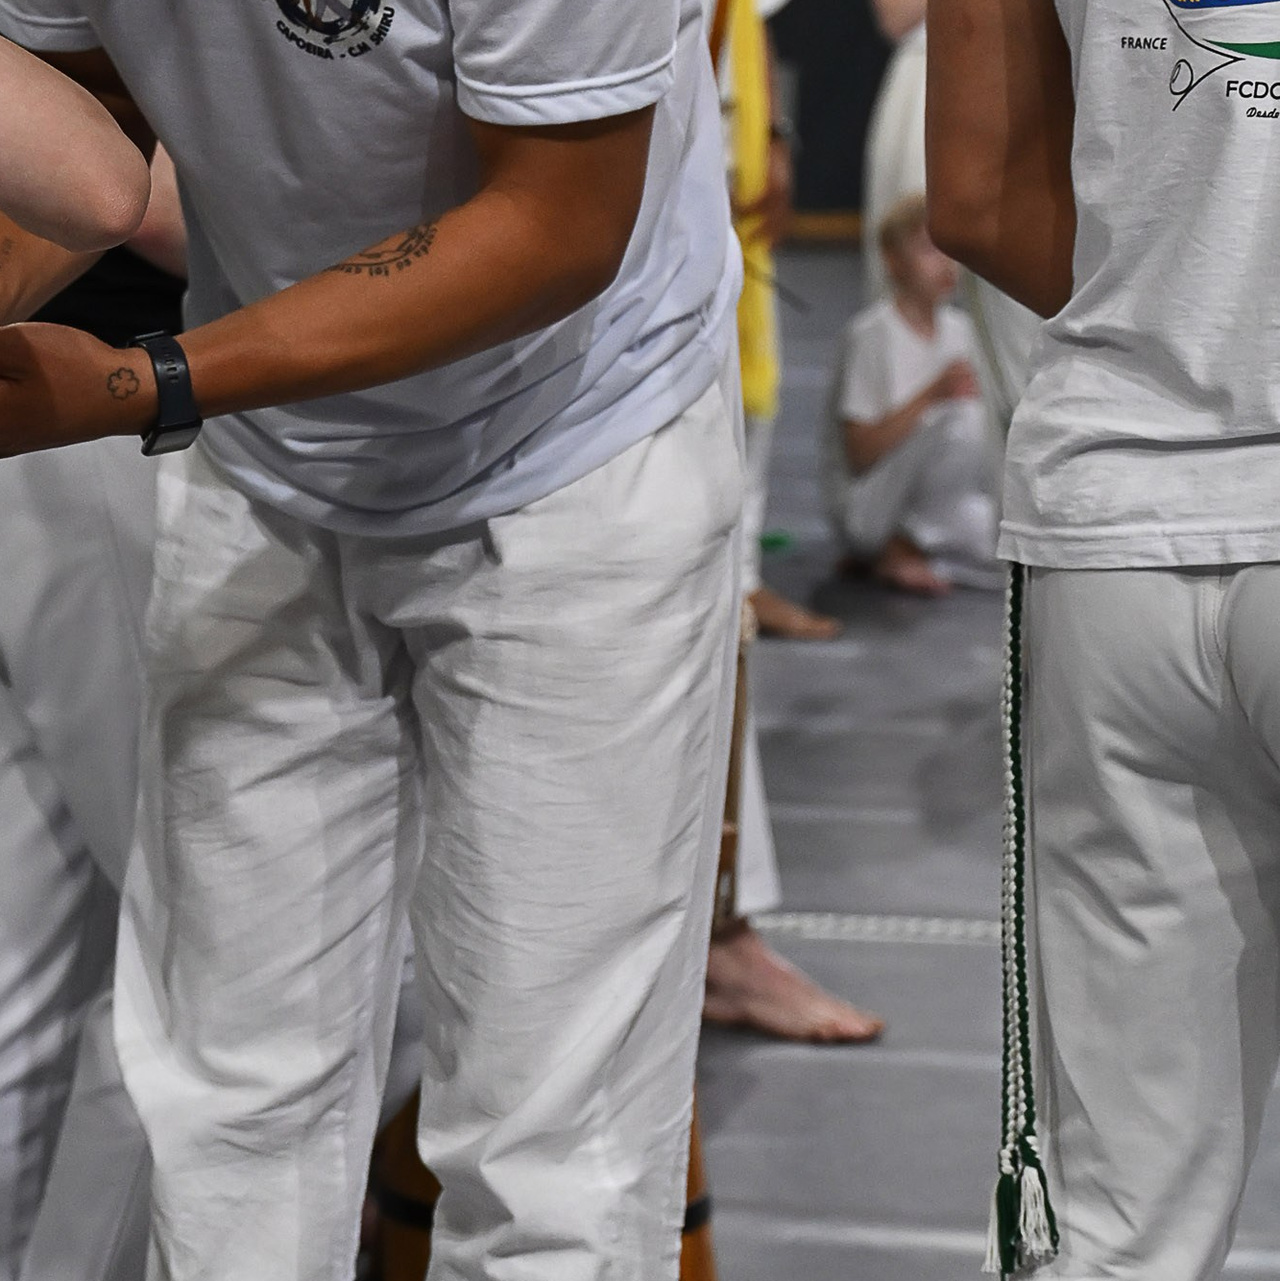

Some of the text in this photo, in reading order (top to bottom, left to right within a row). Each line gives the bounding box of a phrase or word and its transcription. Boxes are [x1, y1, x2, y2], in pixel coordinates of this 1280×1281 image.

[276, 20, 334, 60] CAPOEIRA
[1121, 36, 1168, 50] FRANCE
[1246, 106, 1280, 119] Desde
